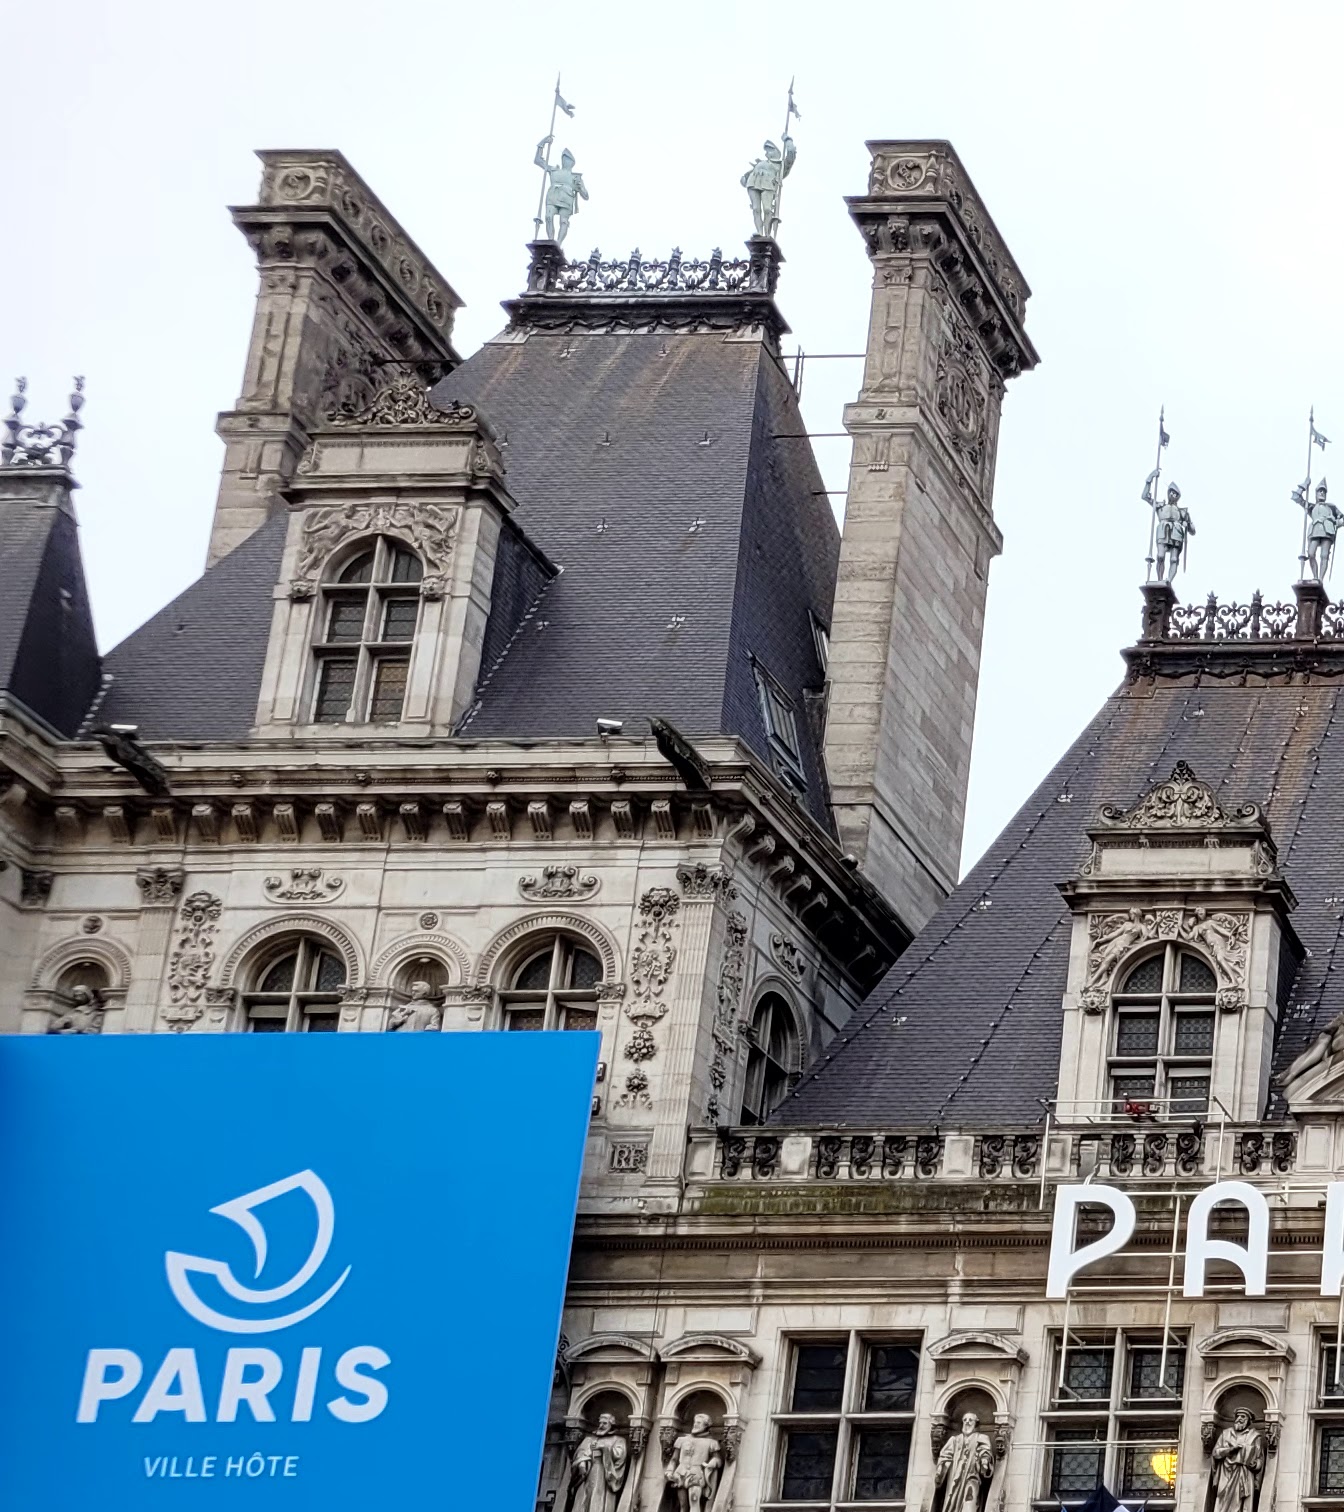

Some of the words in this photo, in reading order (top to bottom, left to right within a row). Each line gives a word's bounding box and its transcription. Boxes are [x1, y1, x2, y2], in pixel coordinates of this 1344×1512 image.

[76, 1345, 391, 1423] PARIS
[143, 1456, 217, 1478] VILLE
[223, 1451, 300, 1478] HÔTE
